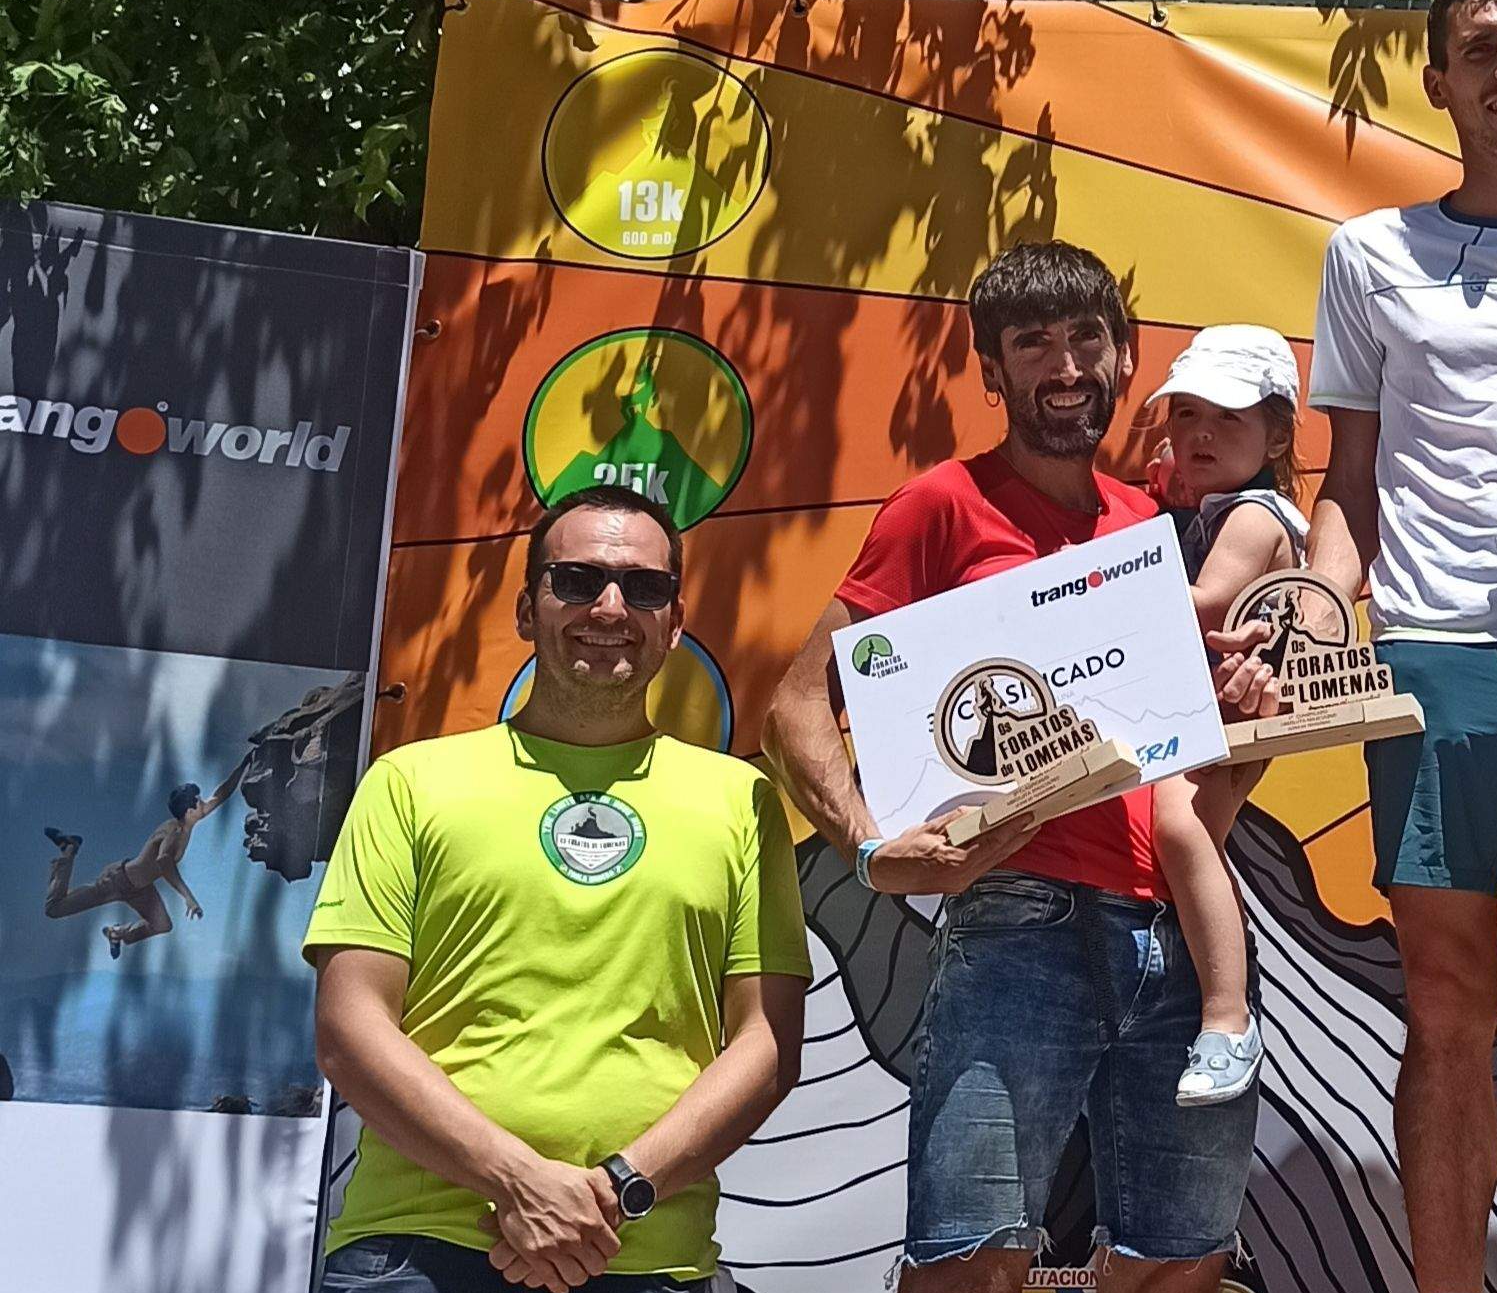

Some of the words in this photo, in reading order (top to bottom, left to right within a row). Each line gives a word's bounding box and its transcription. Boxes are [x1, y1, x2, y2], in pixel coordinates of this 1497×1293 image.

[618, 179, 685, 222] 13k
[1286, 647, 1371, 680] FORATOS
[1291, 639, 1306, 654] Os
[1281, 682, 1295, 697] de
[1299, 668, 1389, 704] LOMENÁS
[997, 722, 1012, 736] Os
[999, 708, 1074, 760] FORATOS
[1000, 763, 1015, 778] de
[1017, 723, 1095, 778] LOMENÁS
